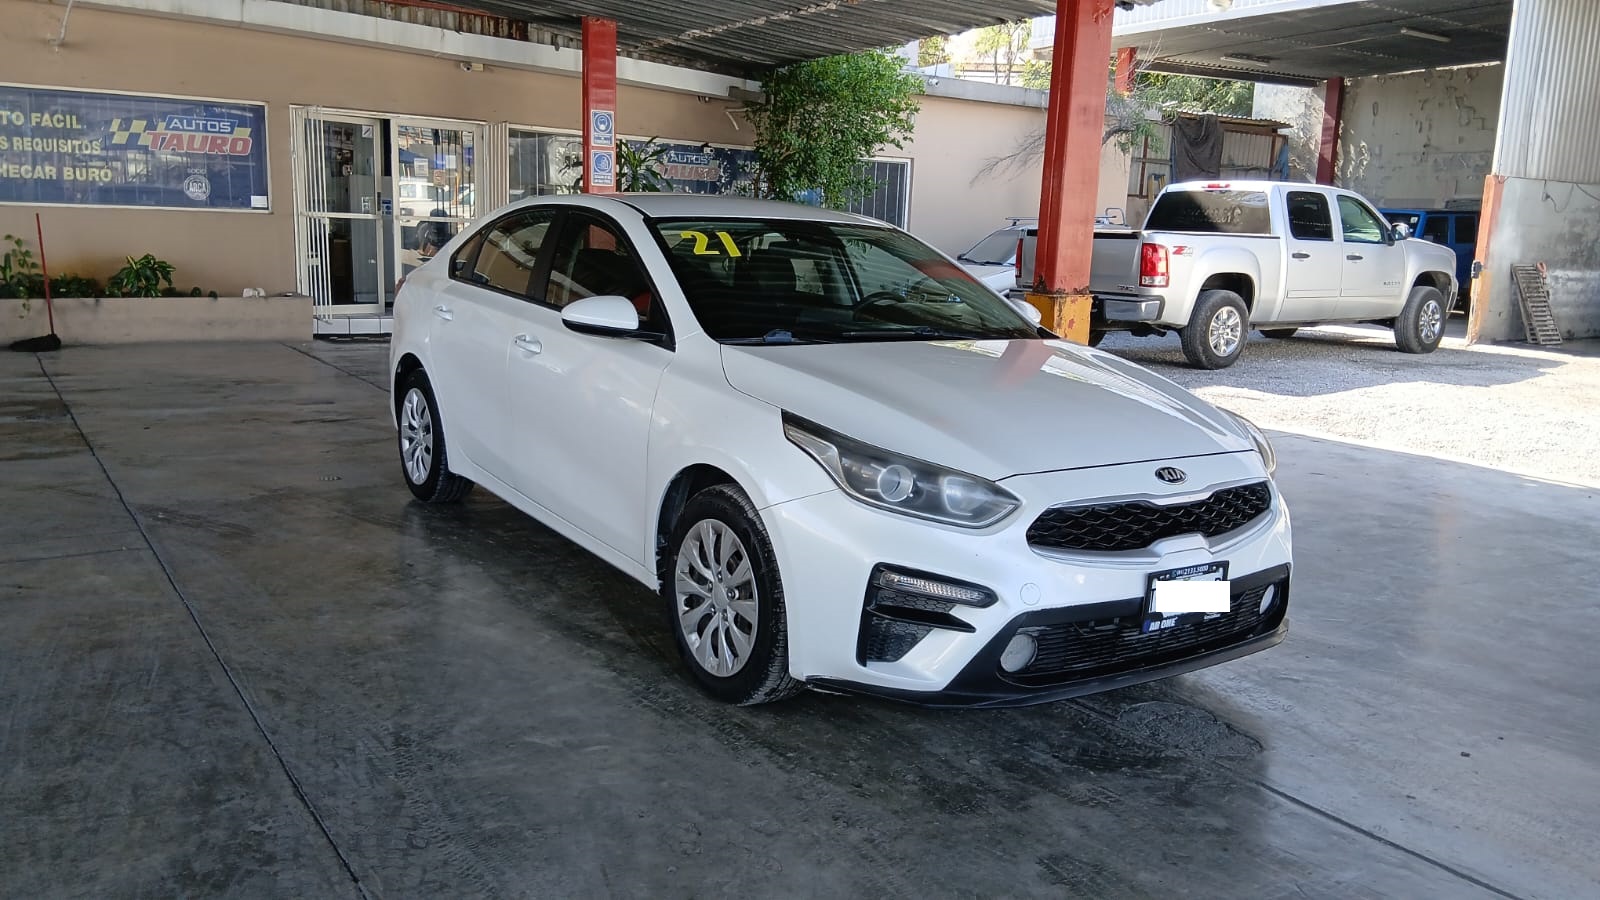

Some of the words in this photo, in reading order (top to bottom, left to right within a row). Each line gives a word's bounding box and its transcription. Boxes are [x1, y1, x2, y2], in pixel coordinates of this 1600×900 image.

[0, 110, 24, 126] TO
[170, 118, 232, 132] AUTOS
[13, 137, 101, 154] REQUISITOS
[146, 131, 252, 155] TAURO
[670, 154, 708, 164] AUTOS
[680, 230, 742, 257] 21
[1160, 468, 1185, 480] KIA
